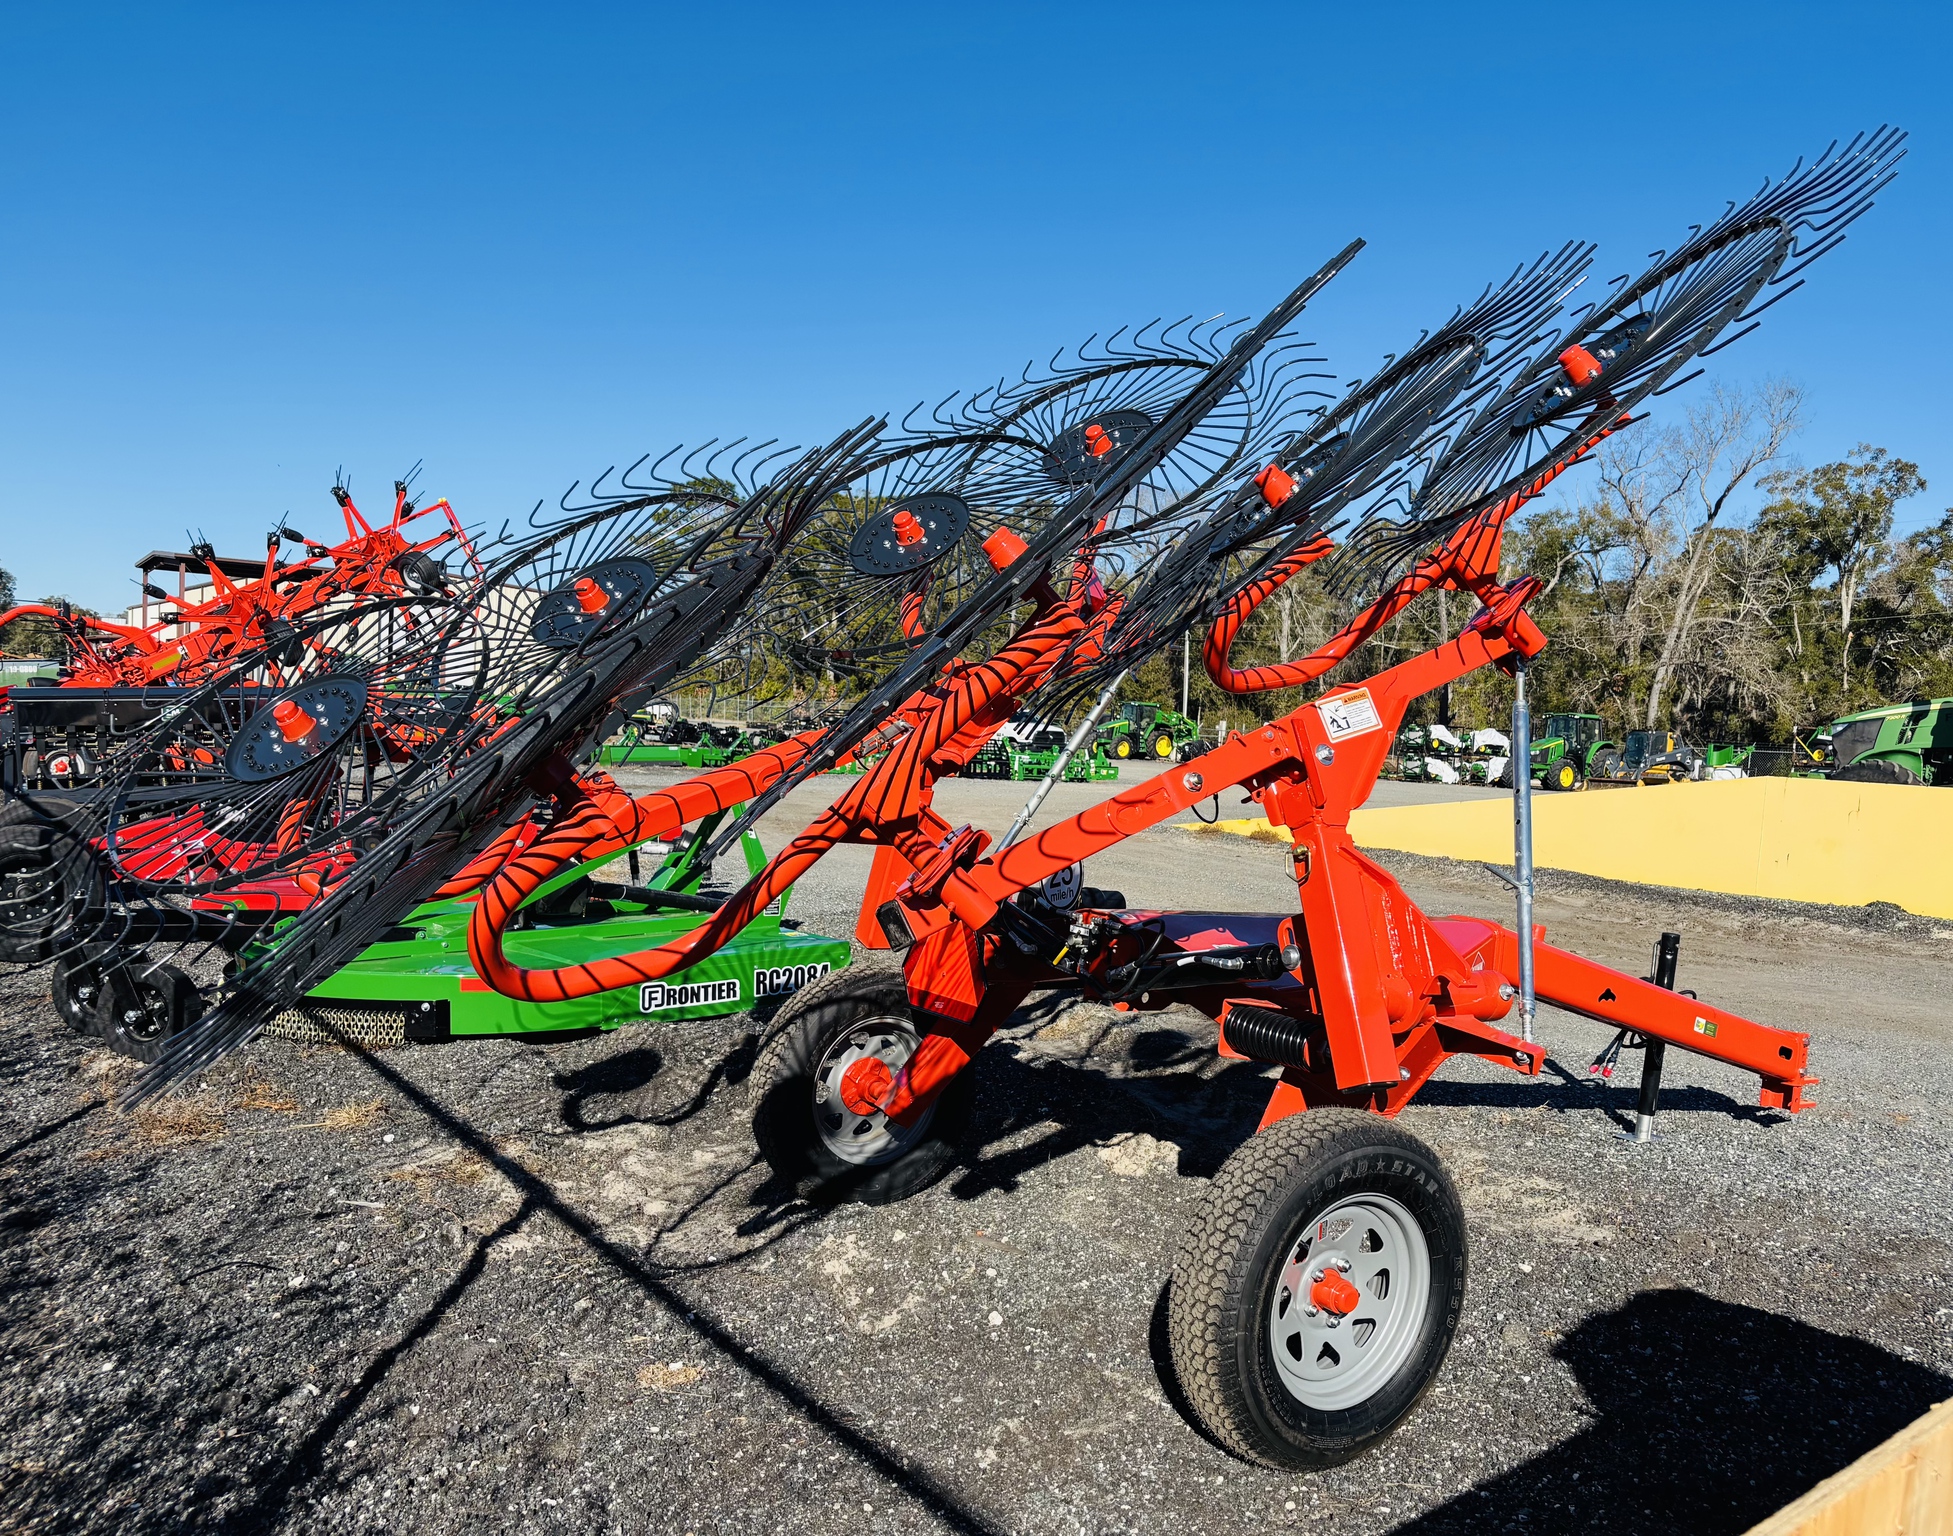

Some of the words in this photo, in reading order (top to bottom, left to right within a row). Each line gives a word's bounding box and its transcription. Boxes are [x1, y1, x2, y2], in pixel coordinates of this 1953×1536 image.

[1050, 865, 1073, 889] 25
[1050, 887, 1074, 902] mile/h
[641, 980, 738, 1011] FRONTIER
[1311, 1159, 1369, 1202] LOAD
[1391, 1160, 1439, 1195] STAR
